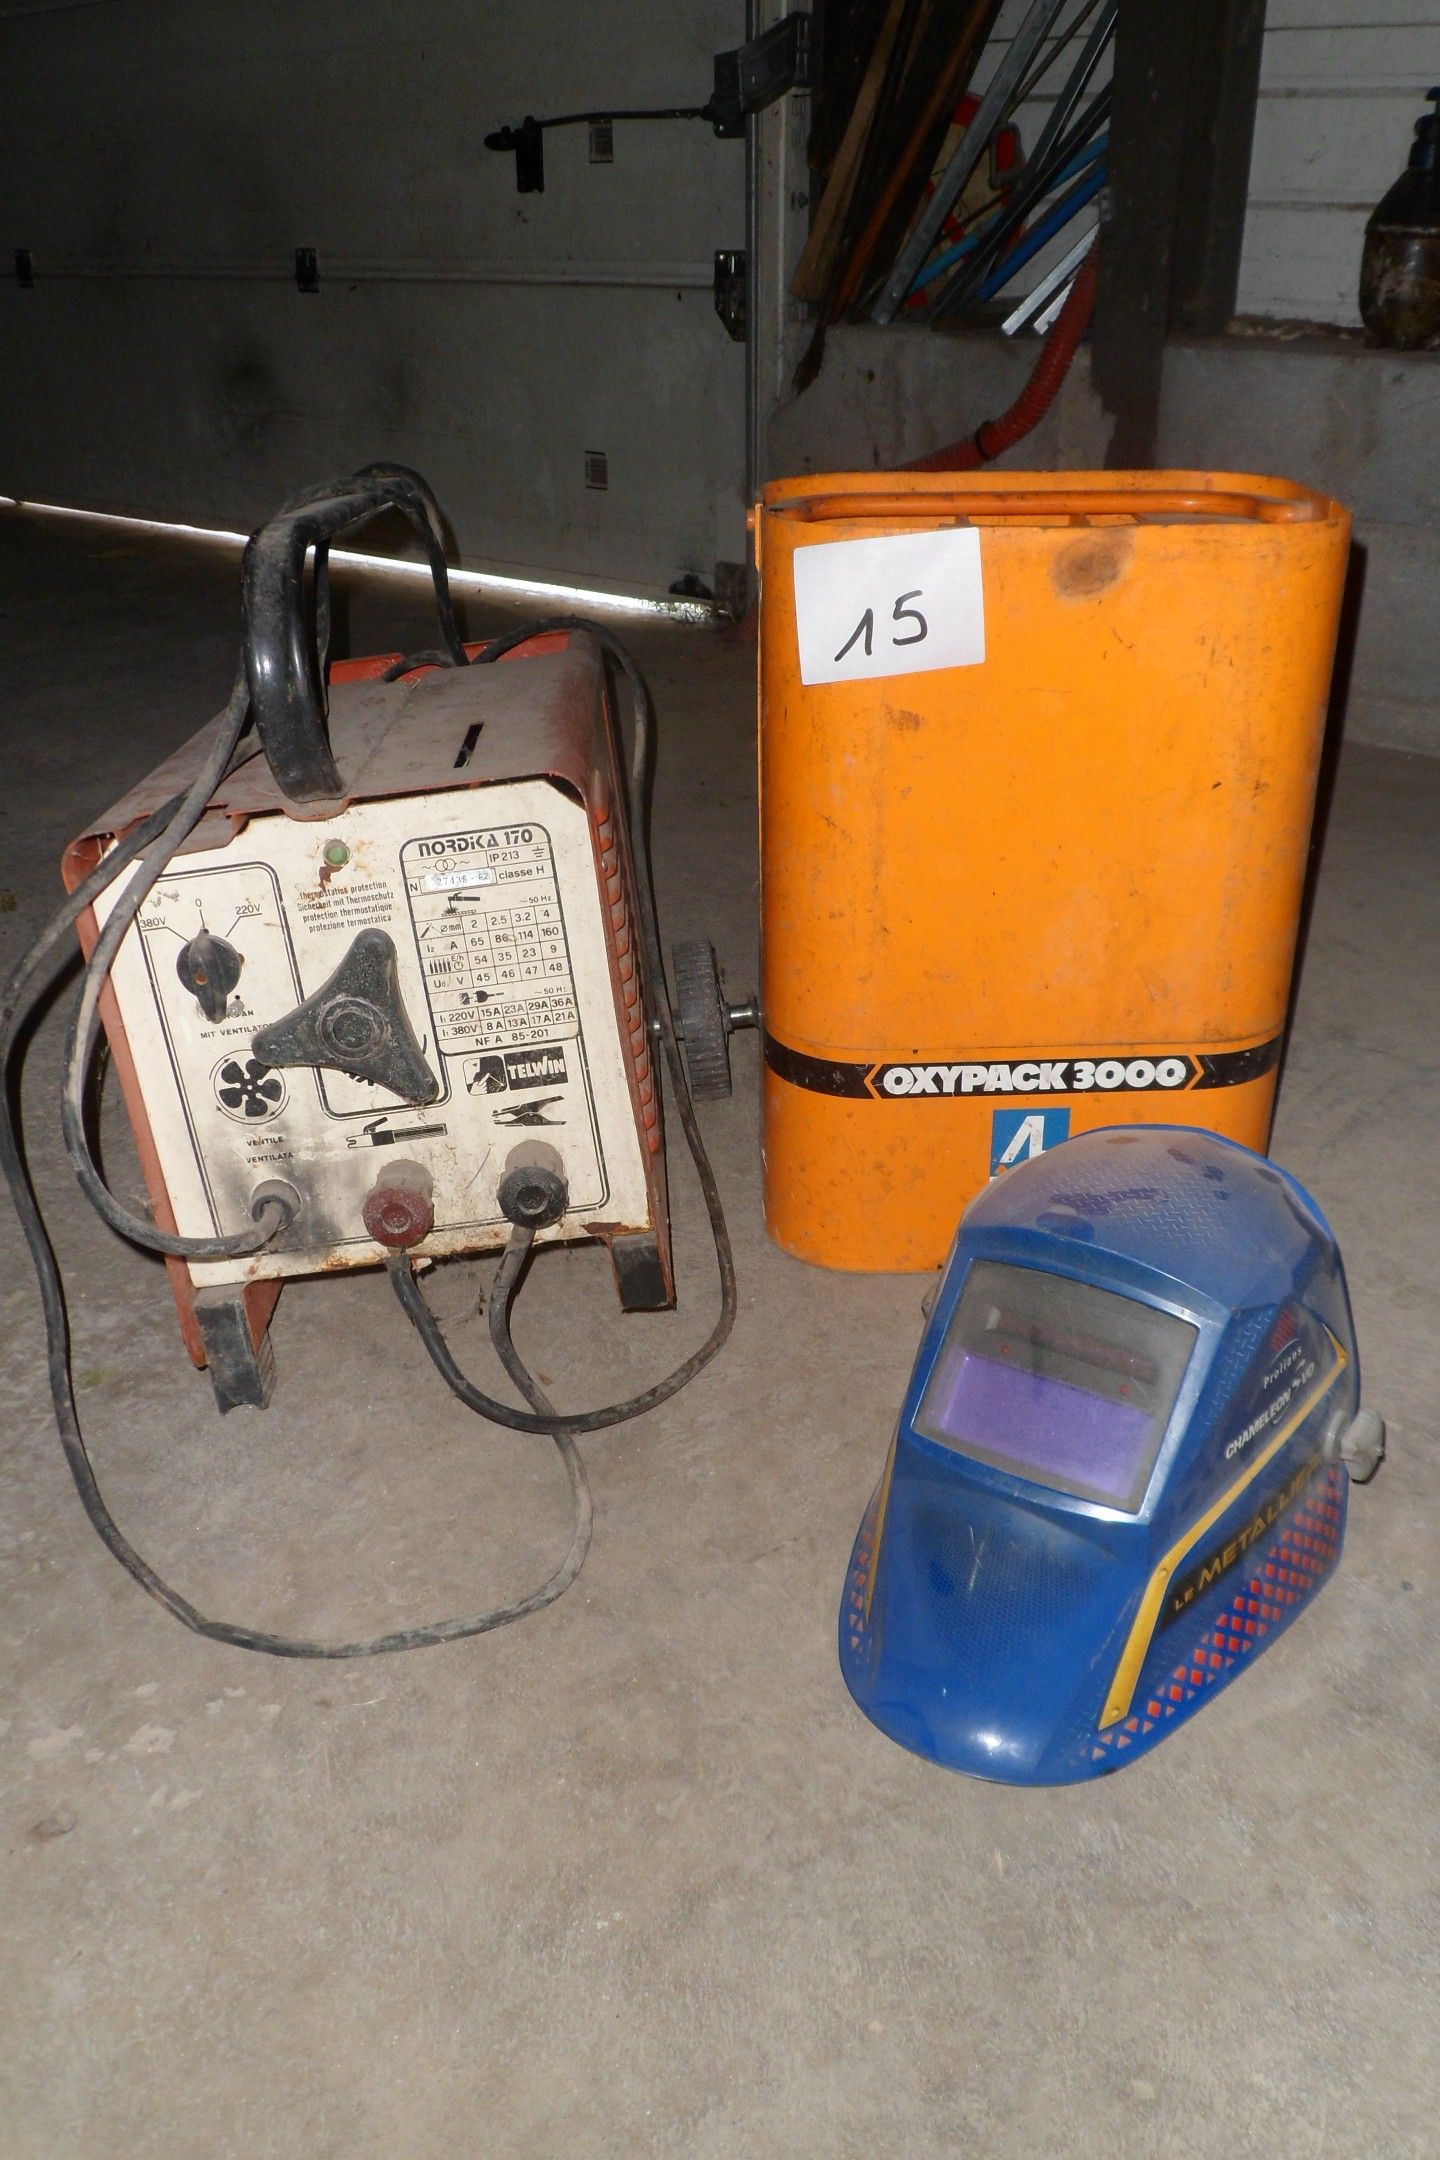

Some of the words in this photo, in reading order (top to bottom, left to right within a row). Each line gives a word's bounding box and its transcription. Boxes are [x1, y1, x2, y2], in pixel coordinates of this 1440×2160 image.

[835, 590, 928, 662] 15
[504, 828, 533, 846] 170
[489, 853, 500, 863] IP
[501, 851, 520, 861] 213
[498, 868, 533, 880] classe
[536, 865, 545, 875] H
[350, 881, 387, 895] protection
[409, 882, 419, 892] N
[235, 904, 261, 915] 220V
[296, 900, 332, 912] Sicherheit
[332, 897, 345, 907] mit
[346, 890, 394, 905] Thermoschutz
[140, 917, 166, 928] 380V
[303, 910, 338, 924] protection
[339, 903, 393, 918] thermostatique
[471, 919, 478, 929] 2
[491, 915, 507, 926] 2.5
[515, 912, 531, 922] 3.2
[543, 909, 550, 918] 4
[308, 921, 345, 934] protezione
[346, 914, 392, 928] termostatica
[450, 940, 458, 950] A
[471, 937, 484, 946] 65
[495, 933, 509, 943] 86
[518, 931, 534, 941] 114
[542, 927, 559, 937] 160
[474, 954, 488, 965] 54
[498, 951, 512, 961] 35
[522, 948, 537, 958] 23
[550, 944, 557, 954] 9
[456, 976, 464, 985] V
[476, 972, 490, 982] 45
[501, 969, 515, 979] 46
[525, 966, 538, 976] 47
[549, 962, 563, 972] 48
[448, 1010, 475, 1023] 220V
[528, 1000, 549, 1011] 29A
[200, 1030, 215, 1039] MIT
[452, 1024, 478, 1036] 380V
[475, 1036, 490, 1047] NF
[495, 1035, 503, 1044] A
[511, 1029, 549, 1041] 85-201
[506, 1055, 565, 1080] TELWIN
[883, 1062, 1068, 1095] OXYPACK
[1072, 1058, 1187, 1089] 3000
[246, 1136, 285, 1147] VENTILE
[246, 1151, 294, 1164] VENTILATA
[1225, 1387, 1291, 1460] CHAMELEON
